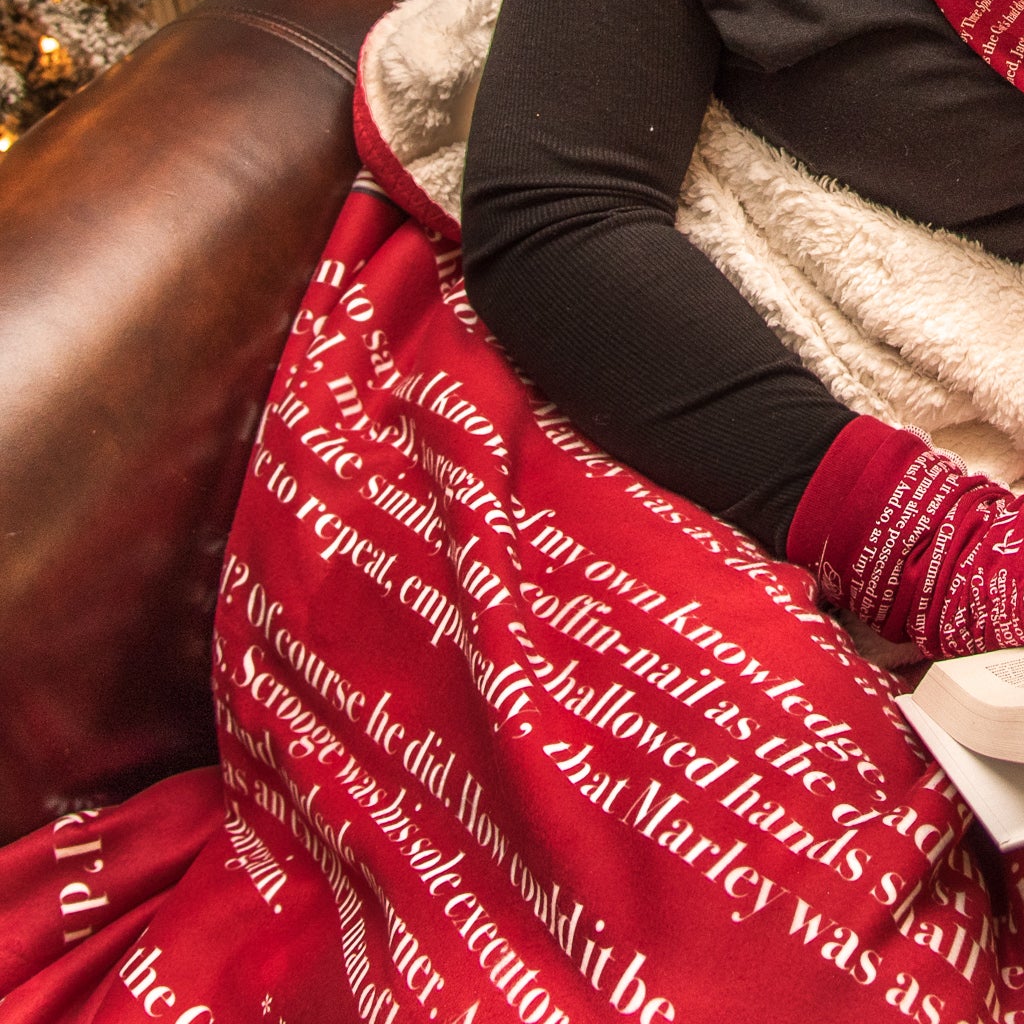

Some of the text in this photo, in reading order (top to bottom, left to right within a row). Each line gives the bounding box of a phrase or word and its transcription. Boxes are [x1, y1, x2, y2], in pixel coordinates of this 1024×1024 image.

[338, 282, 375, 323] to
[361, 328, 403, 391] say
[531, 525, 596, 574] my
[584, 552, 663, 615] own
[660, 599, 888, 803] knowledge,
[624, 481, 693, 526] was
[682, 525, 731, 555] as
[724, 555, 825, 626] dead
[866, 477, 933, 599] man alive possessed
[869, 528, 882, 543] as
[889, 480, 911, 508] And
[922, 522, 955, 594] Christmas
[927, 494, 945, 515] was
[299, 425, 364, 480] the
[461, 559, 518, 622] my
[719, 773, 874, 883] hands
[326, 373, 838, 795] myself, coffin-nail as the
[230, 643, 347, 765] Scrooge
[333, 752, 392, 809] was
[369, 785, 425, 844] his
[399, 834, 467, 897] sole
[266, 461, 299, 505] to
[295, 493, 400, 598] repeat,
[542, 739, 632, 815] that
[616, 777, 793, 923] Marley
[788, 892, 884, 986] was
[246, 583, 284, 640] Of
[274, 628, 368, 723] course
[364, 691, 408, 756] he
[402, 729, 457, 808] did.
[455, 770, 511, 867] How
[511, 851, 585, 959] could
[579, 918, 616, 992] it
[608, 949, 677, 1024] be
[118, 946, 177, 1019] the
